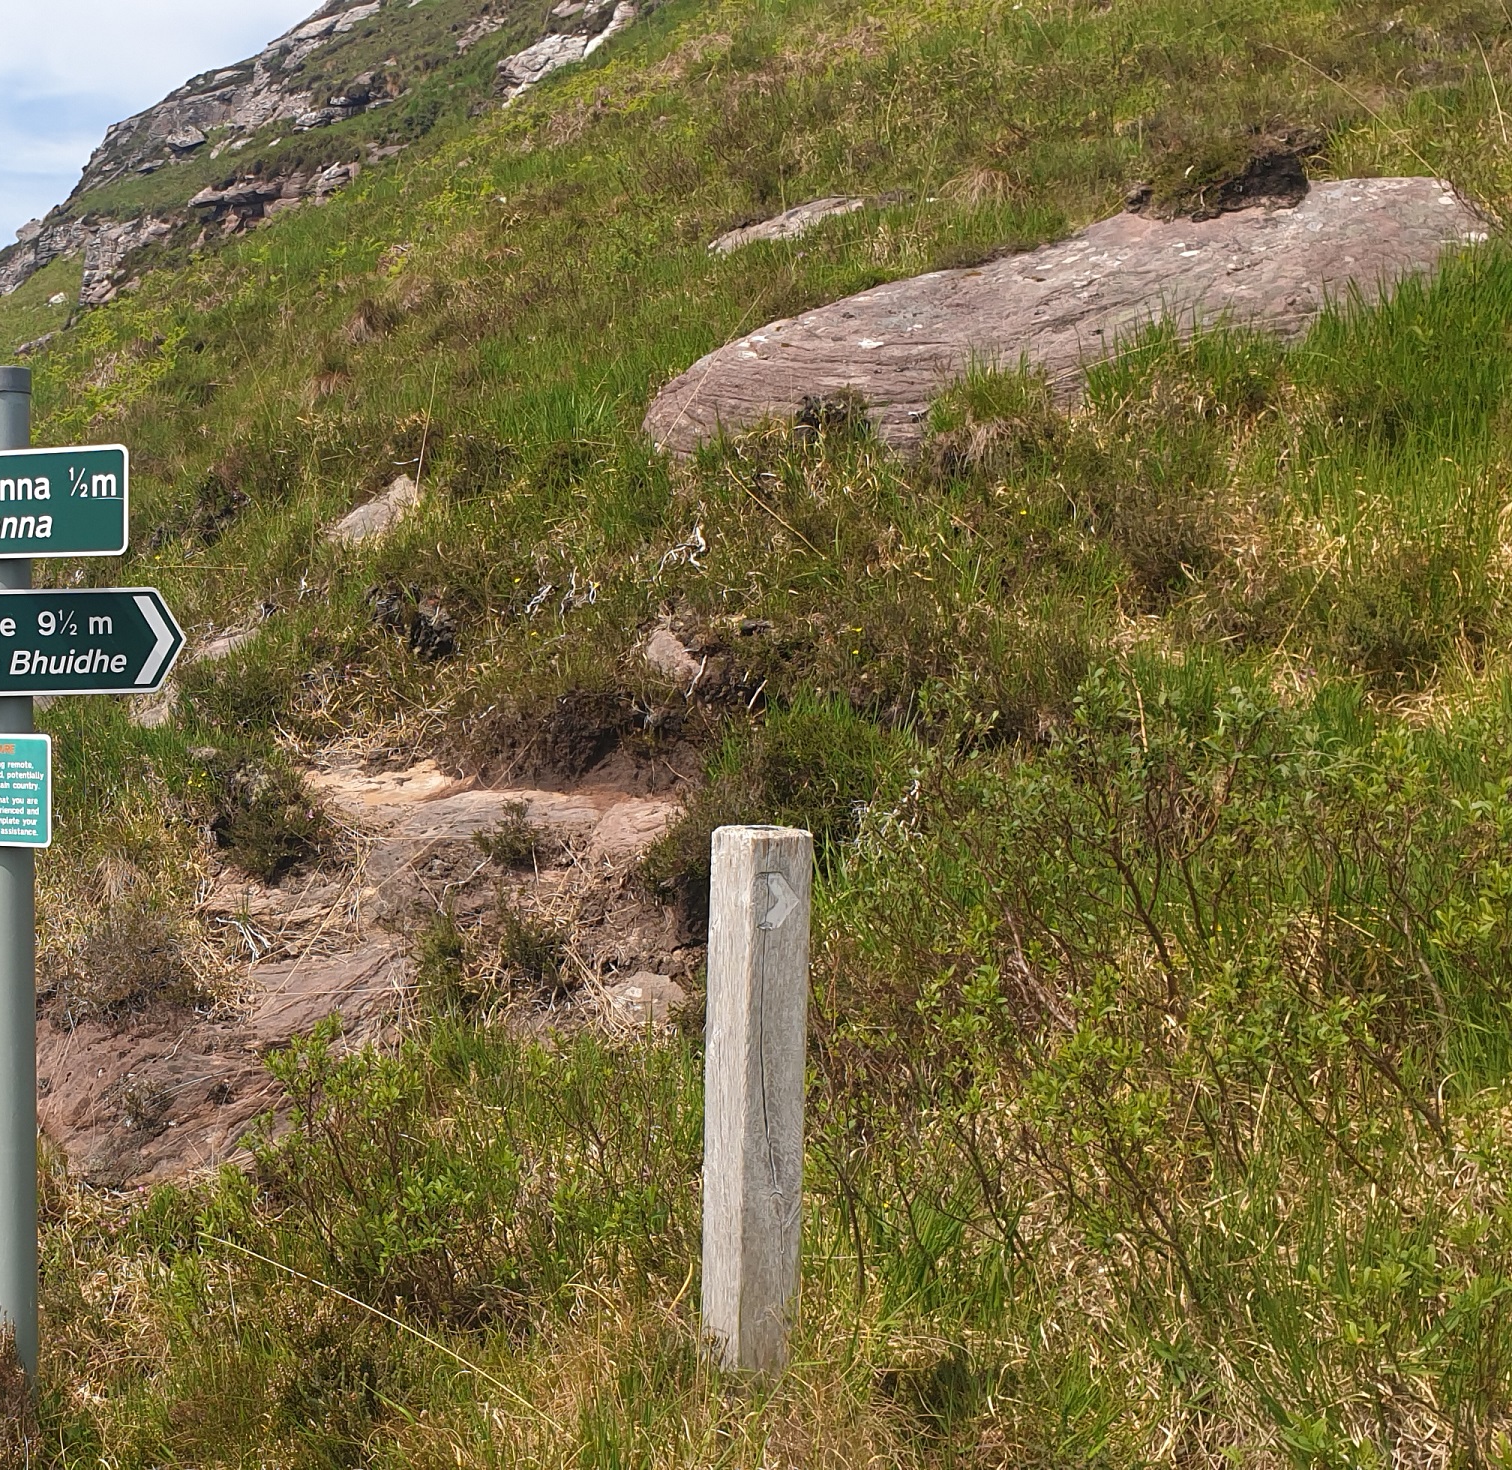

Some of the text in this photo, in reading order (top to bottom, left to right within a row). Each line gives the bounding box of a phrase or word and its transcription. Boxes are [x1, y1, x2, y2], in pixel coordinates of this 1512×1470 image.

[89, 615, 113, 635] m
[9, 649, 127, 676] Bhuidhe
[7, 771, 44, 780] potentially
[1, 828, 38, 836] assistance.
